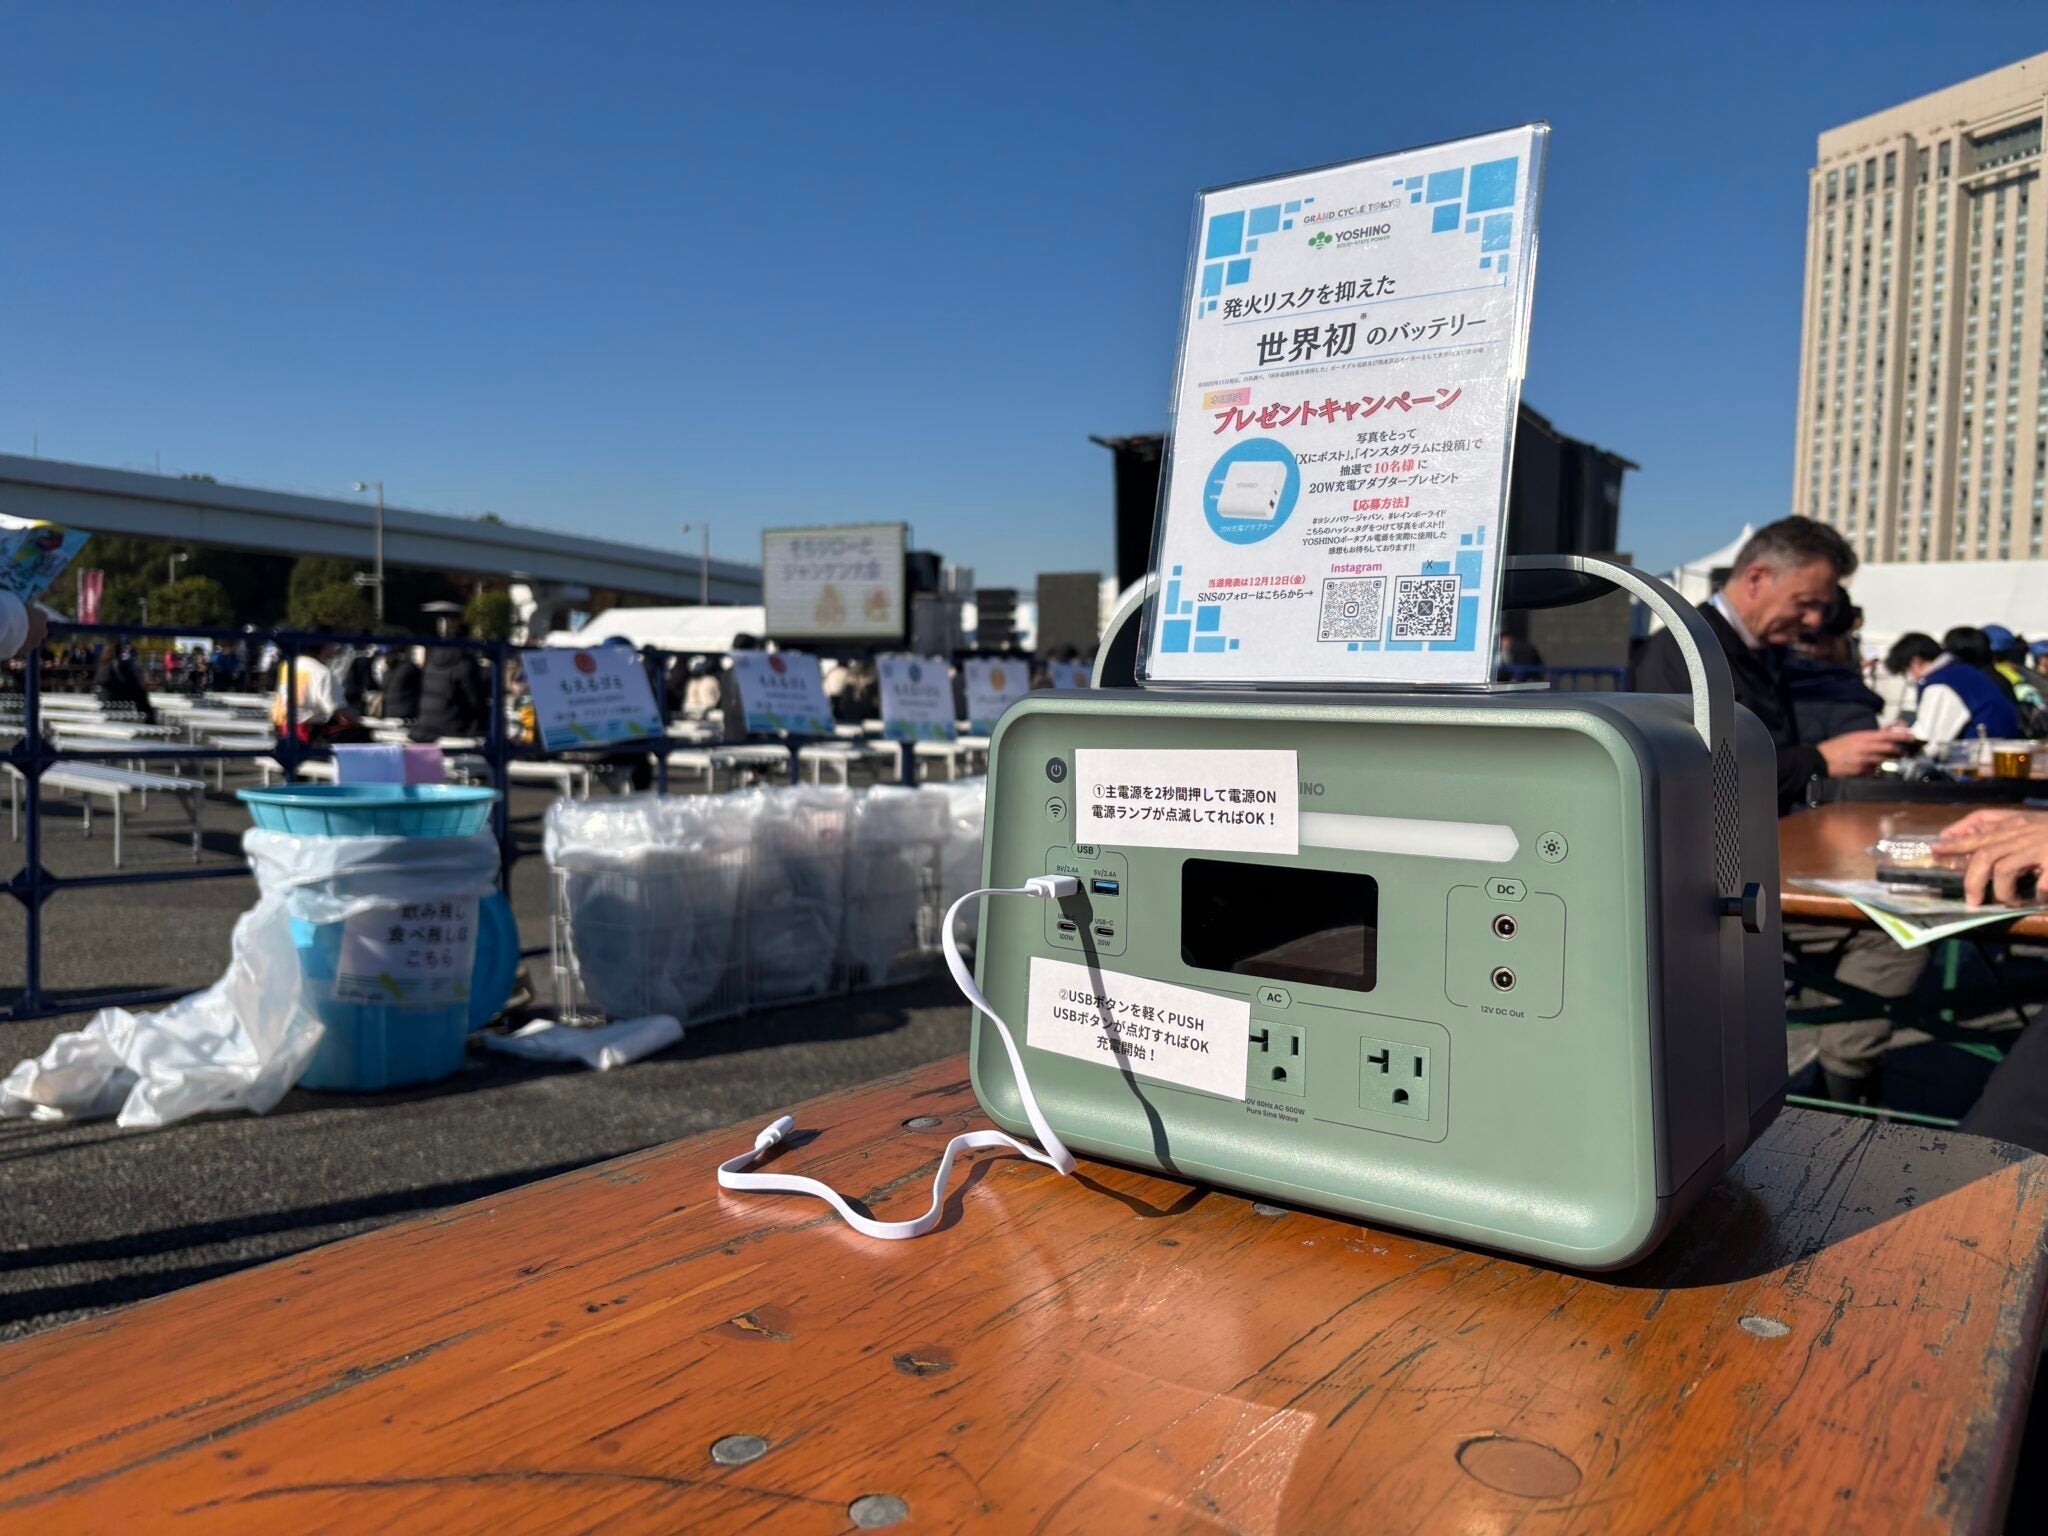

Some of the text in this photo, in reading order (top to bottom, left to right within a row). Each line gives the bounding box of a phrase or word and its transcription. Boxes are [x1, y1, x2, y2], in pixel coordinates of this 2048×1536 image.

[1303, 198, 1401, 224] GRAND CYCLE TOKYO
[1335, 223, 1391, 243] YOSHINO
[1370, 235, 1391, 244] POWER
[1222, 274, 1396, 321] 発火リスクを抑えた
[1213, 388, 1462, 435] プレゼントキャンペーン
[1356, 428, 1417, 444] 写真をとって
[1308, 472, 1459, 494] 20W充電アダプタープレゼント
[1331, 563, 1383, 575] Instagram
[1425, 560, 1434, 570] X
[1092, 783, 1277, 804] ①主電源を2秒間押して電源ON
[1076, 845, 1094, 855] USB
[1093, 868, 1117, 878] 5V/2.4A
[1497, 884, 1515, 895] DC
[1094, 917, 1114, 926] USB-C
[1058, 933, 1075, 941] 100W
[1097, 939, 1111, 947] 20W
[405, 948, 454, 970] こちら
[1266, 992, 1282, 1003] AC
[1058, 987, 1205, 1032] ②USBボタンを軽くPUSH
[1480, 1005, 1525, 1018] 12V DC Out
[1052, 1005, 1210, 1054] USBボタンが点灯すればOK
[1274, 1103, 1284, 1112] AC
[1246, 1106, 1299, 1123] Pure Sine Wave
